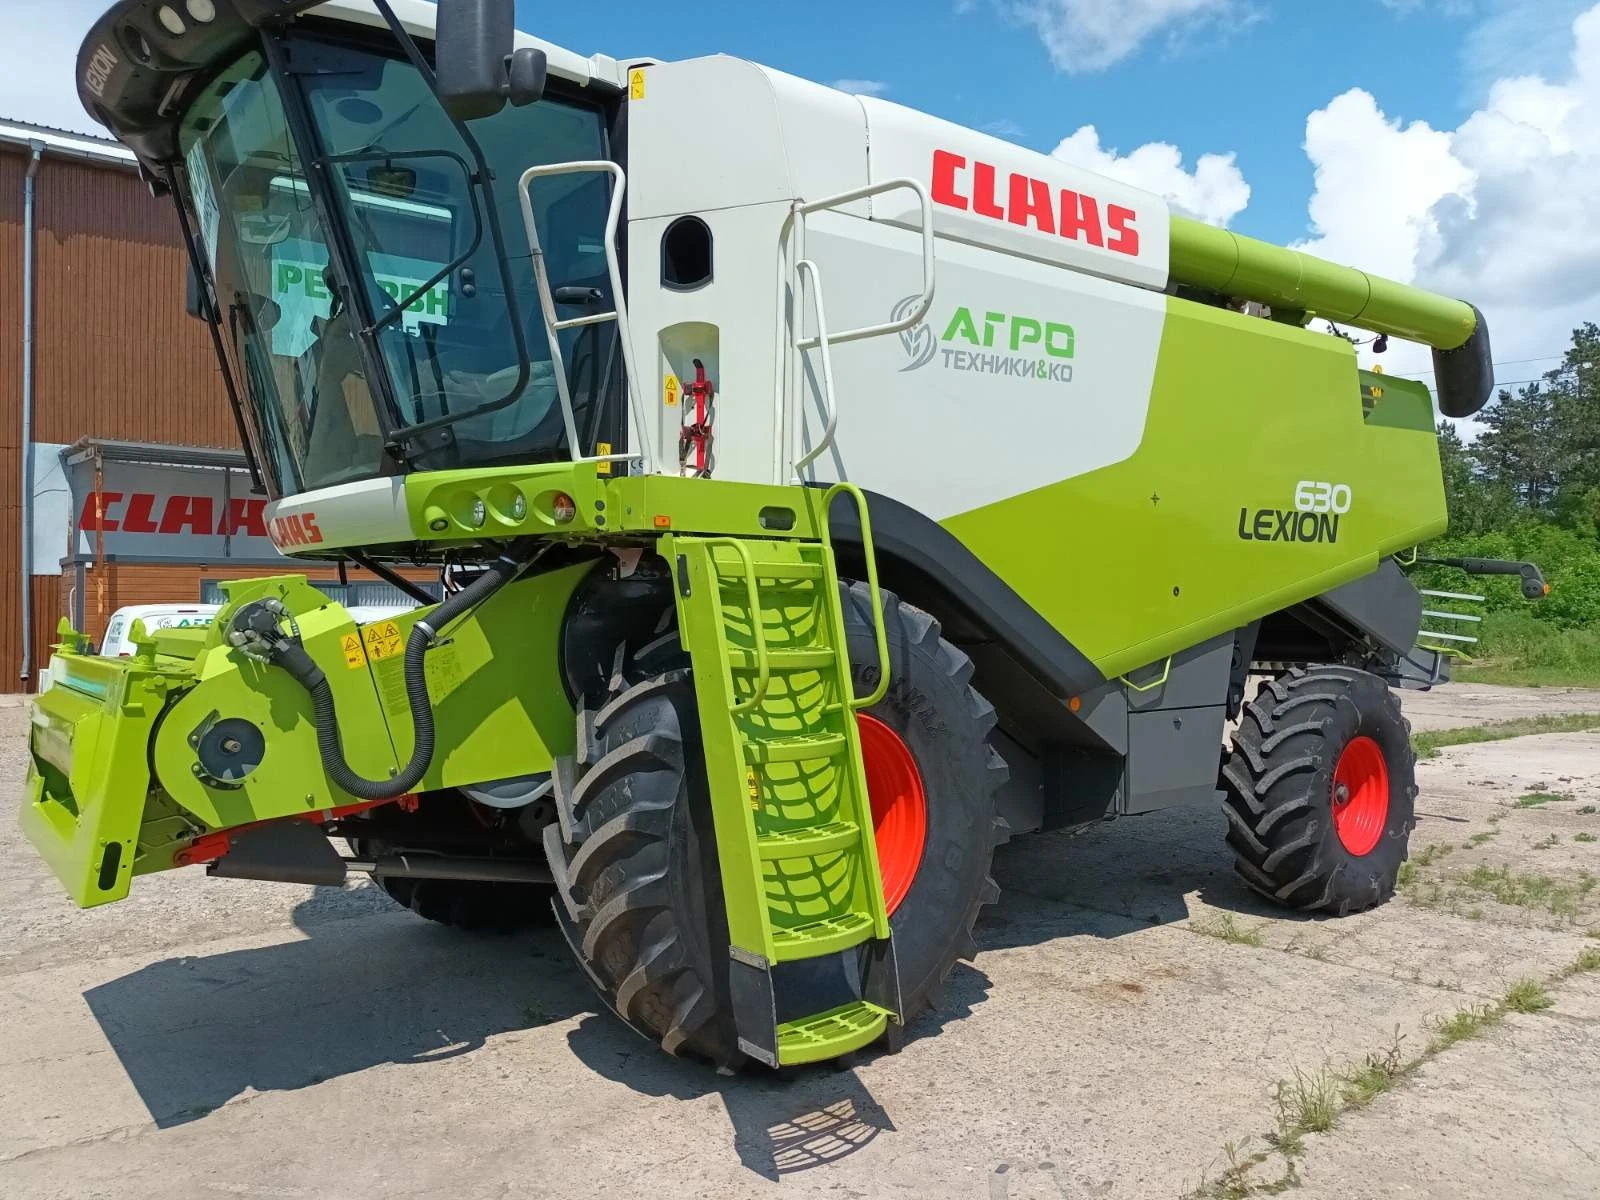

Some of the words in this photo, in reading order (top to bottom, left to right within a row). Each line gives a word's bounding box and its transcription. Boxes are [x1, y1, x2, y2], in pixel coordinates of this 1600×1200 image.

[84, 44, 118, 97] LEXION
[931, 149, 1139, 257] CLAAS
[941, 306, 1075, 359] АГРО
[941, 348, 1073, 382] ТЕХНИКИ&КО
[80, 491, 268, 537] CLAA
[1294, 480, 1352, 514] 630
[272, 512, 324, 549] AAS
[1238, 507, 1339, 543] LEXION
